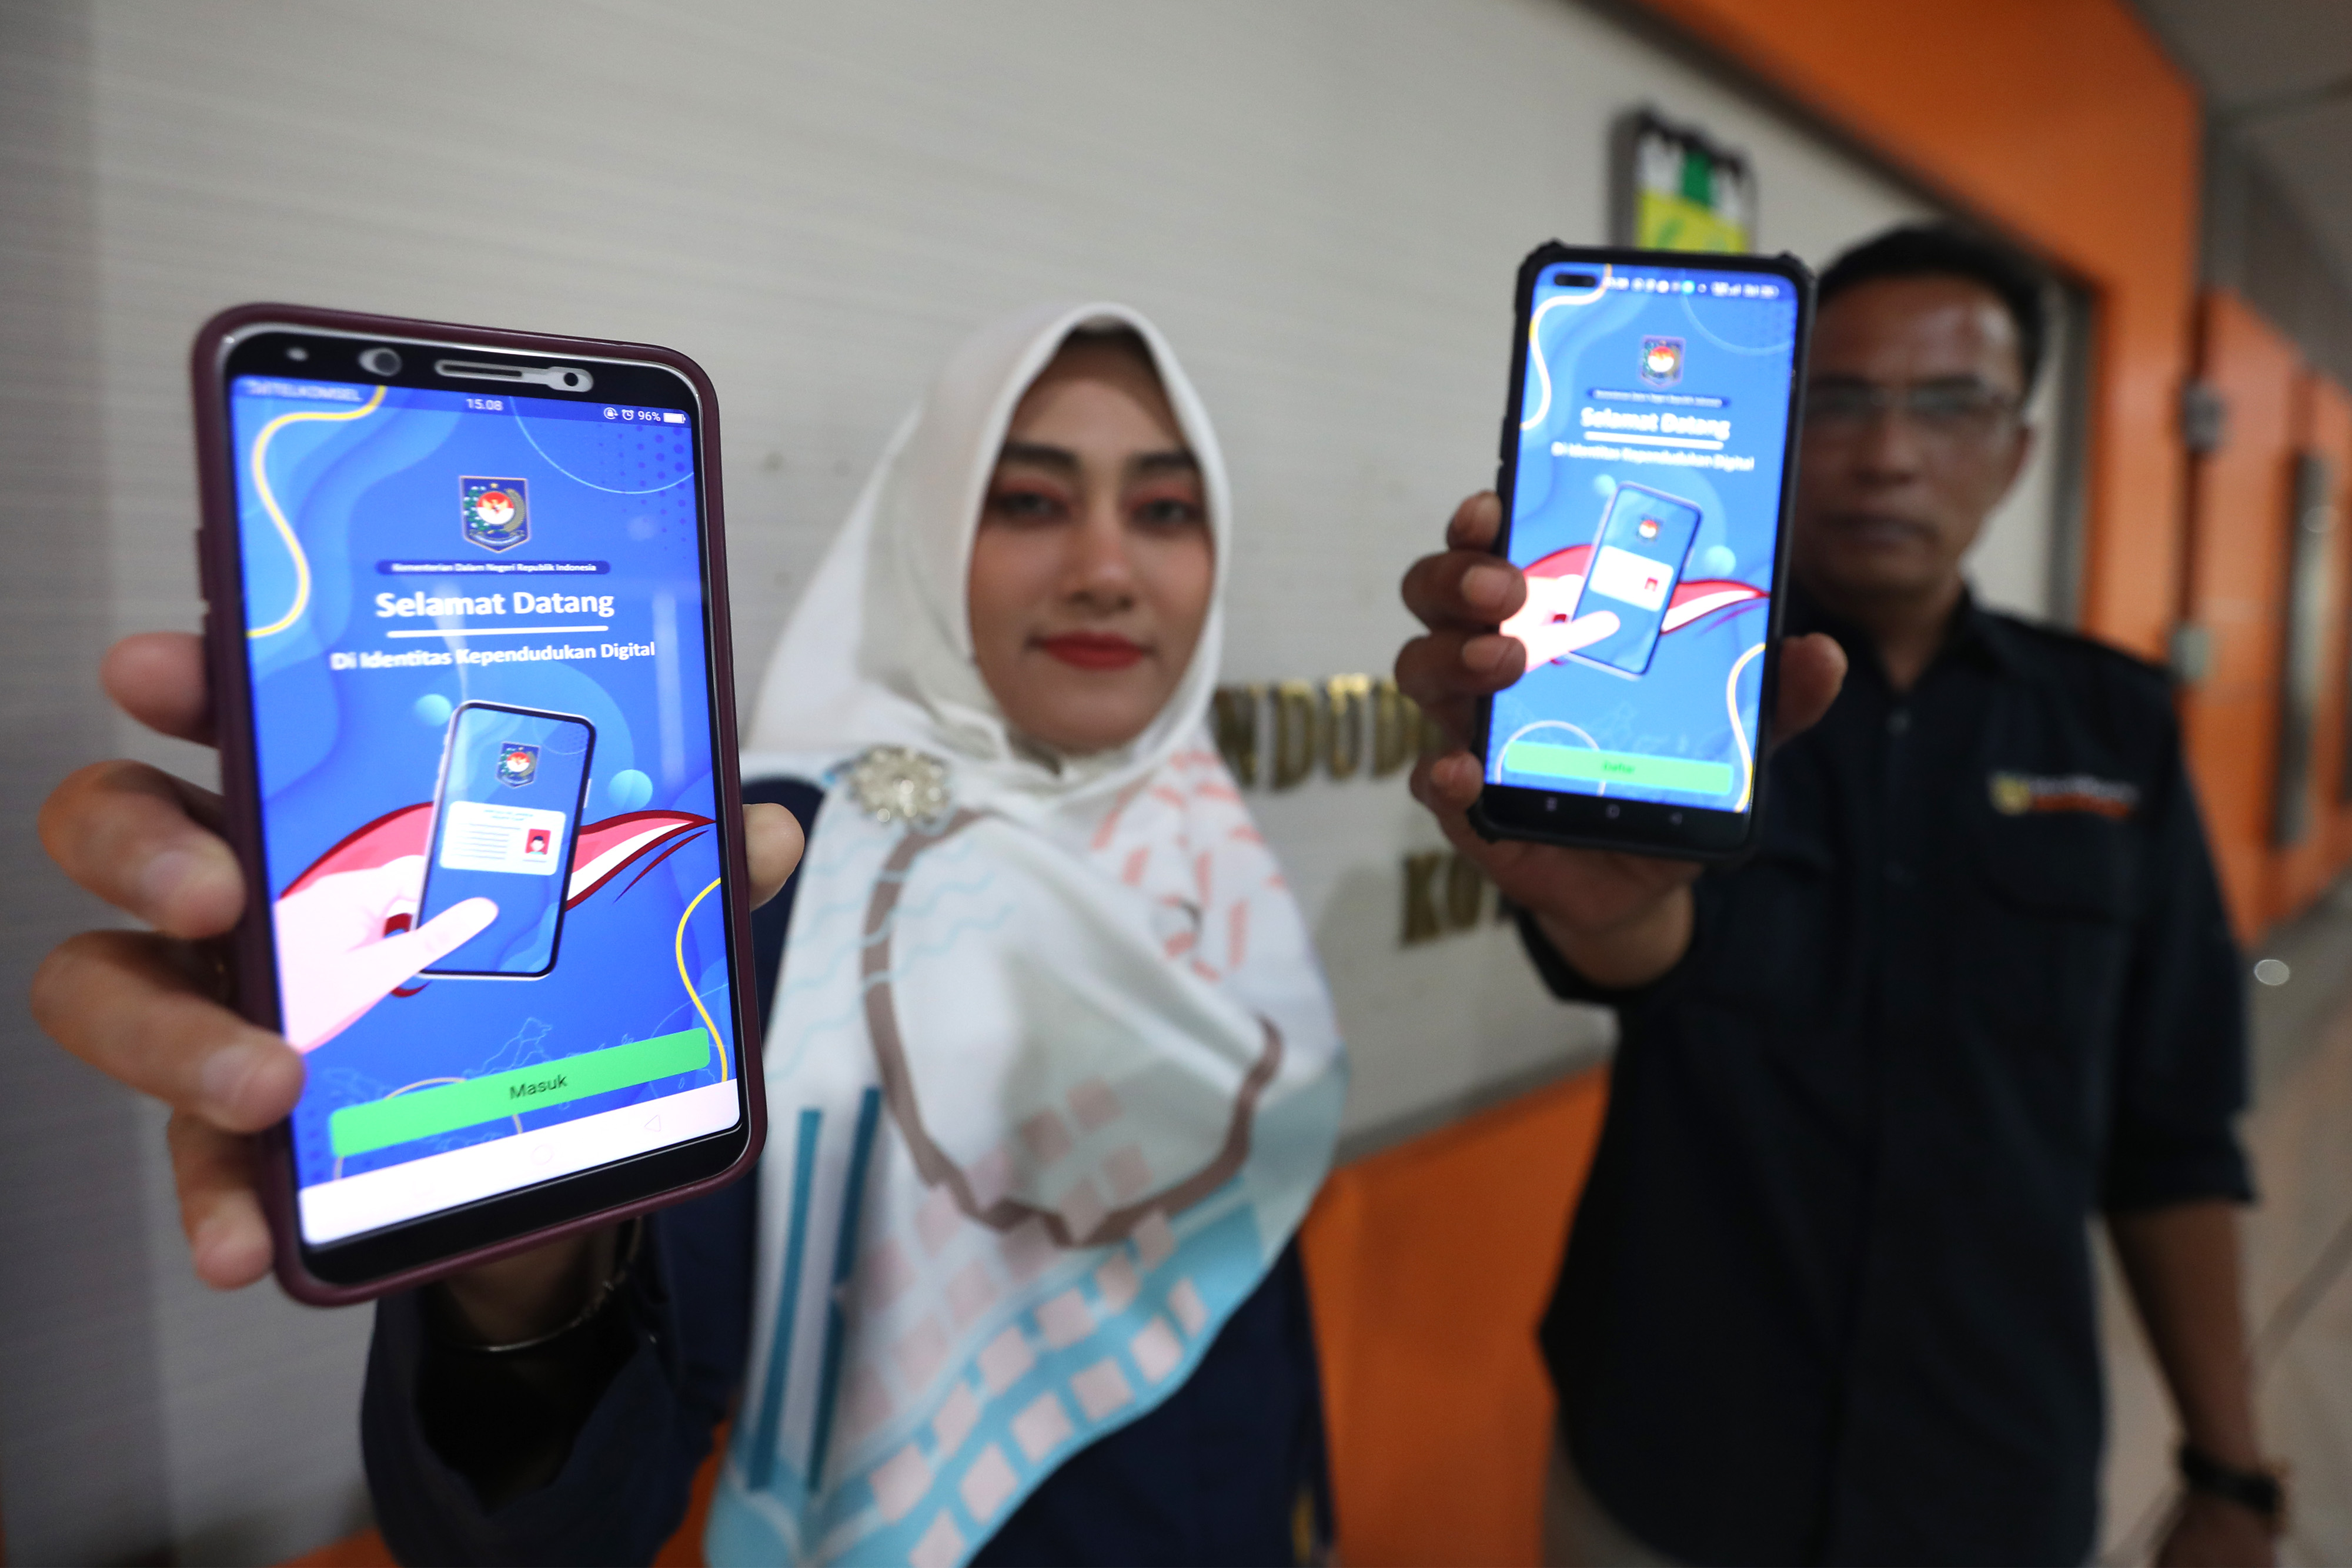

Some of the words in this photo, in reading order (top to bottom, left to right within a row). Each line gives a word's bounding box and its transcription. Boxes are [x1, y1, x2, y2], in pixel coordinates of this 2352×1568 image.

[466, 399, 503, 411] 15.08
[638, 411, 661, 422] 96%
[1581, 407, 1659, 432] Selamat
[1661, 413, 1731, 440] Datang
[455, 563, 484, 572] Dalam
[486, 563, 515, 573] Negeri
[517, 563, 554, 572] Republik
[376, 591, 506, 617] Selamat
[513, 591, 614, 617] Datang
[330, 651, 357, 670] Di
[360, 649, 452, 668] Identitas
[456, 644, 596, 666] Kependudukan
[601, 641, 655, 660] Digital
[510, 1074, 568, 1100] Masuk
